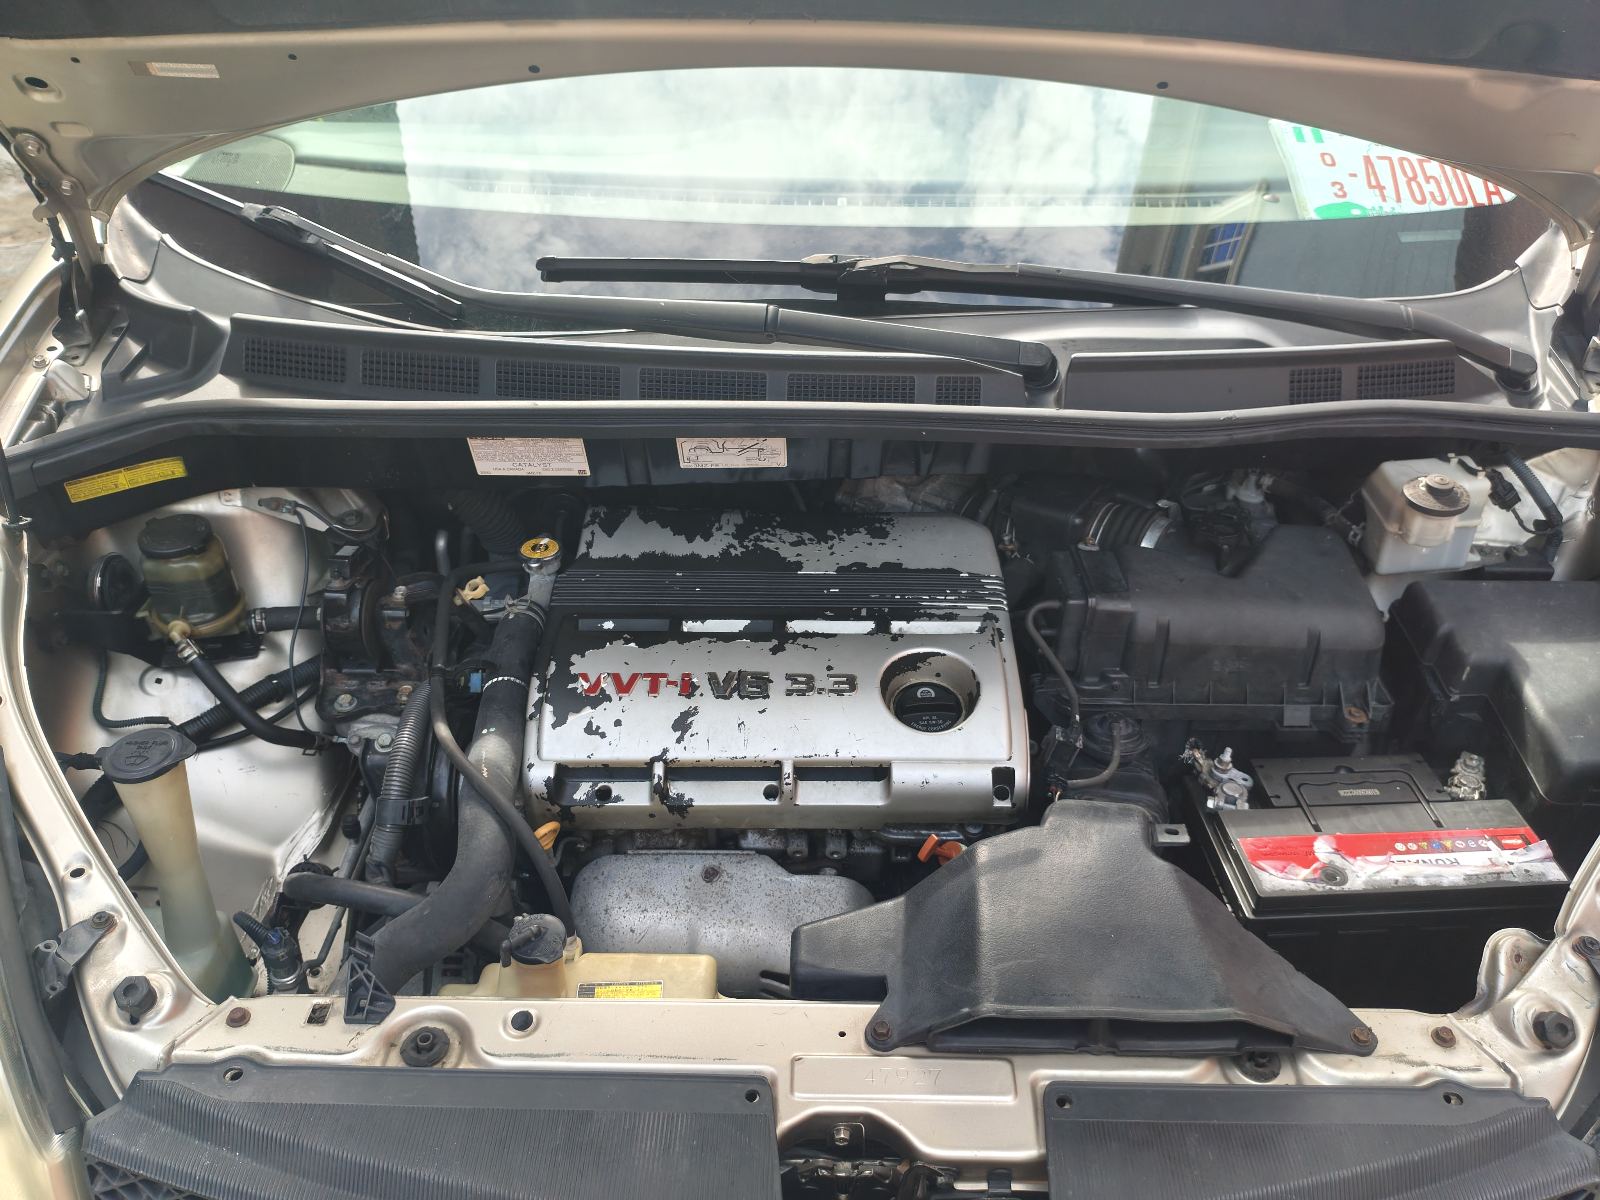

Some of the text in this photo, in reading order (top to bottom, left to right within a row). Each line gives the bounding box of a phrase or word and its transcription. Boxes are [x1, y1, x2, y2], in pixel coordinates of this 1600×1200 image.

[577, 670, 857, 699] VVT-i V6 3.3
